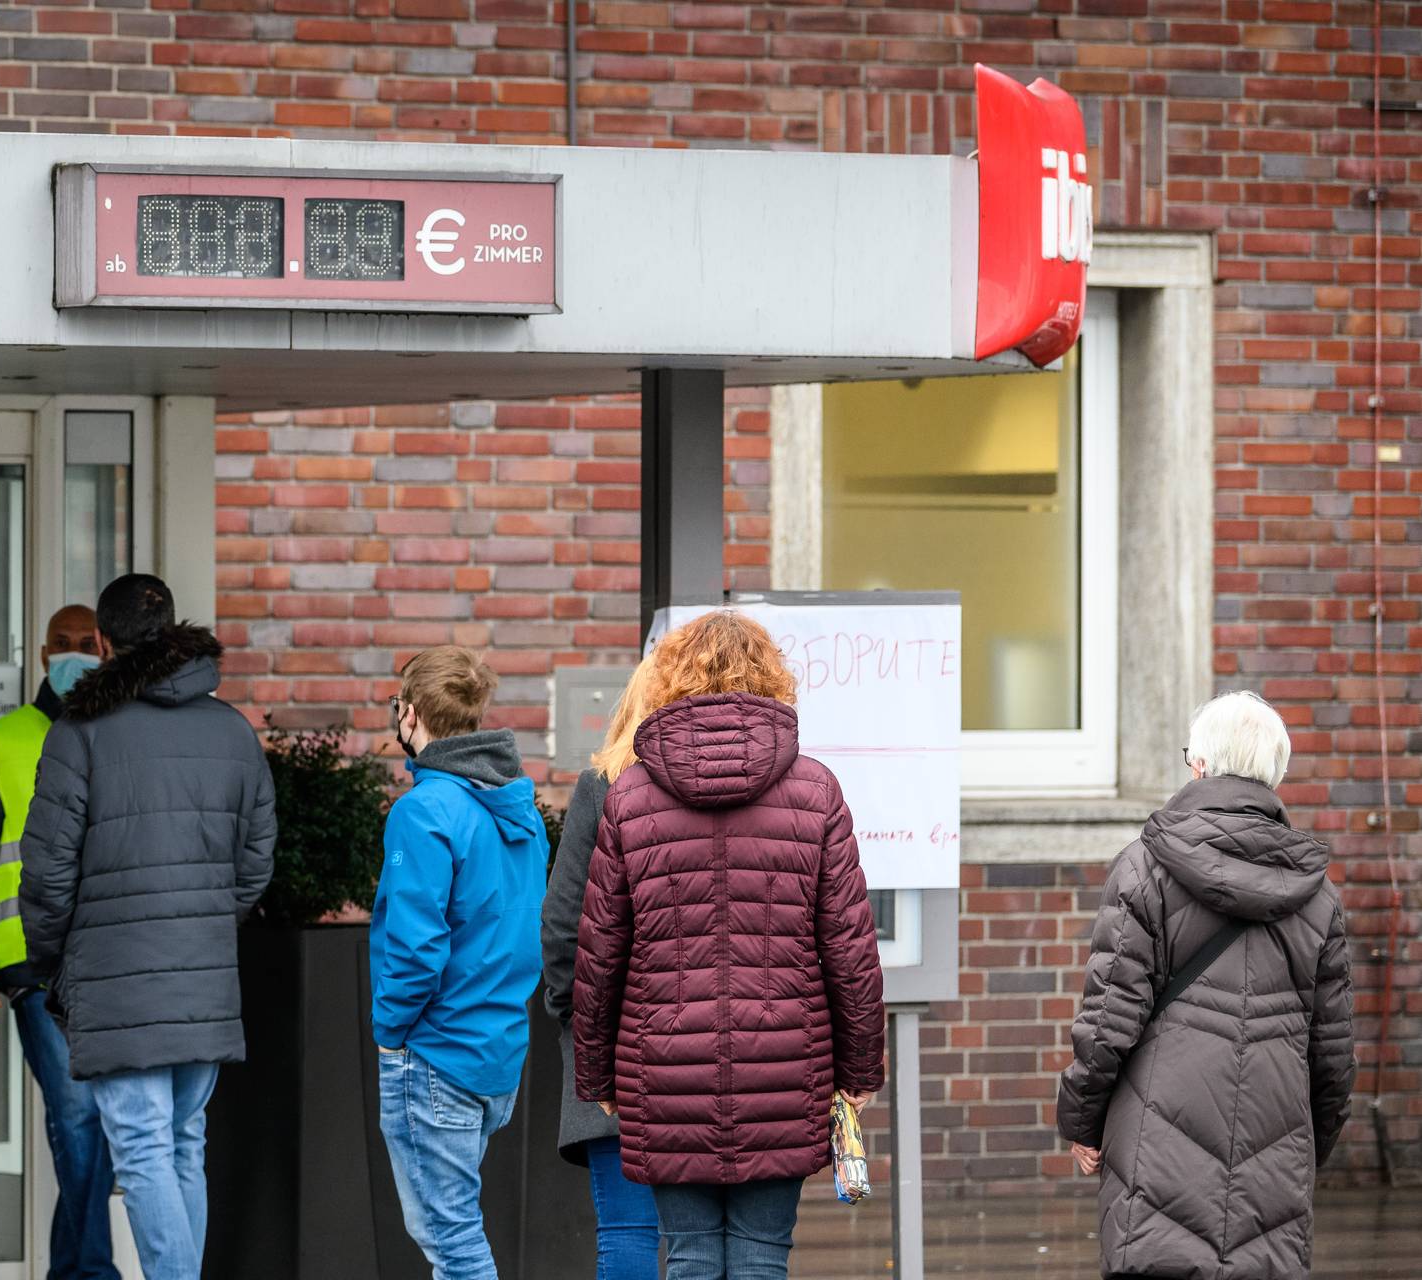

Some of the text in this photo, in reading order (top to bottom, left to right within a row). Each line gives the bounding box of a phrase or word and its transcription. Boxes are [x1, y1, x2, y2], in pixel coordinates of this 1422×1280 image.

[489, 223, 528, 243] PRO
[105, 255, 127, 273] ab
[473, 245, 543, 264] ZIMMER
